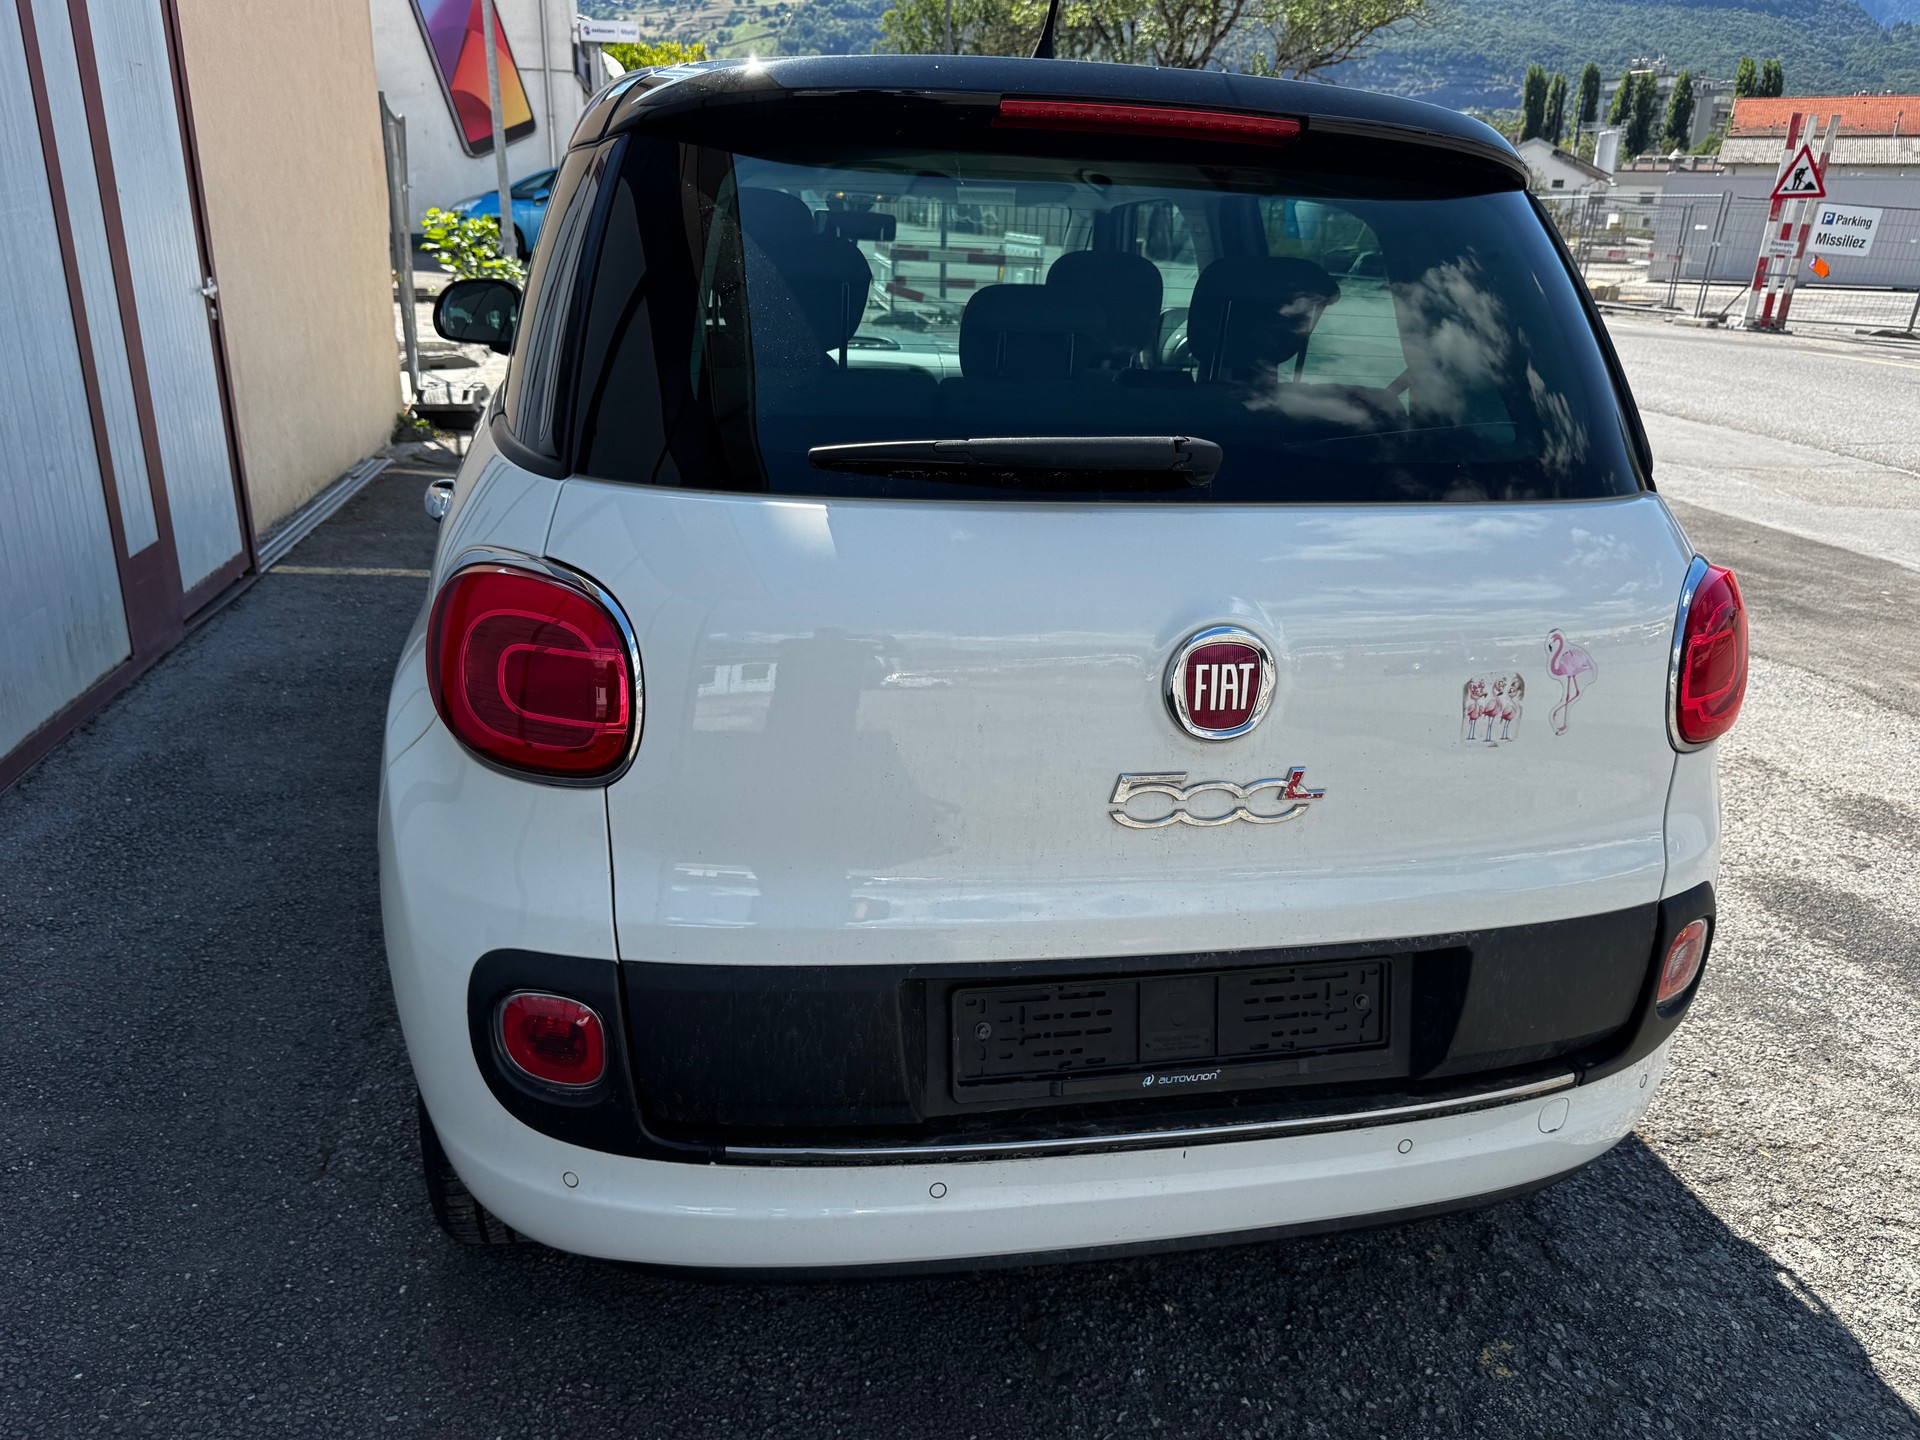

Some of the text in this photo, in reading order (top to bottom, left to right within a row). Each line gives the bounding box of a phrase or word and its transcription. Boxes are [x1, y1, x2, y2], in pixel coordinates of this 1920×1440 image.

[1836, 214, 1873, 230] Parking
[1815, 232, 1867, 249] Missiliez
[1193, 663, 1255, 711] FIAT
